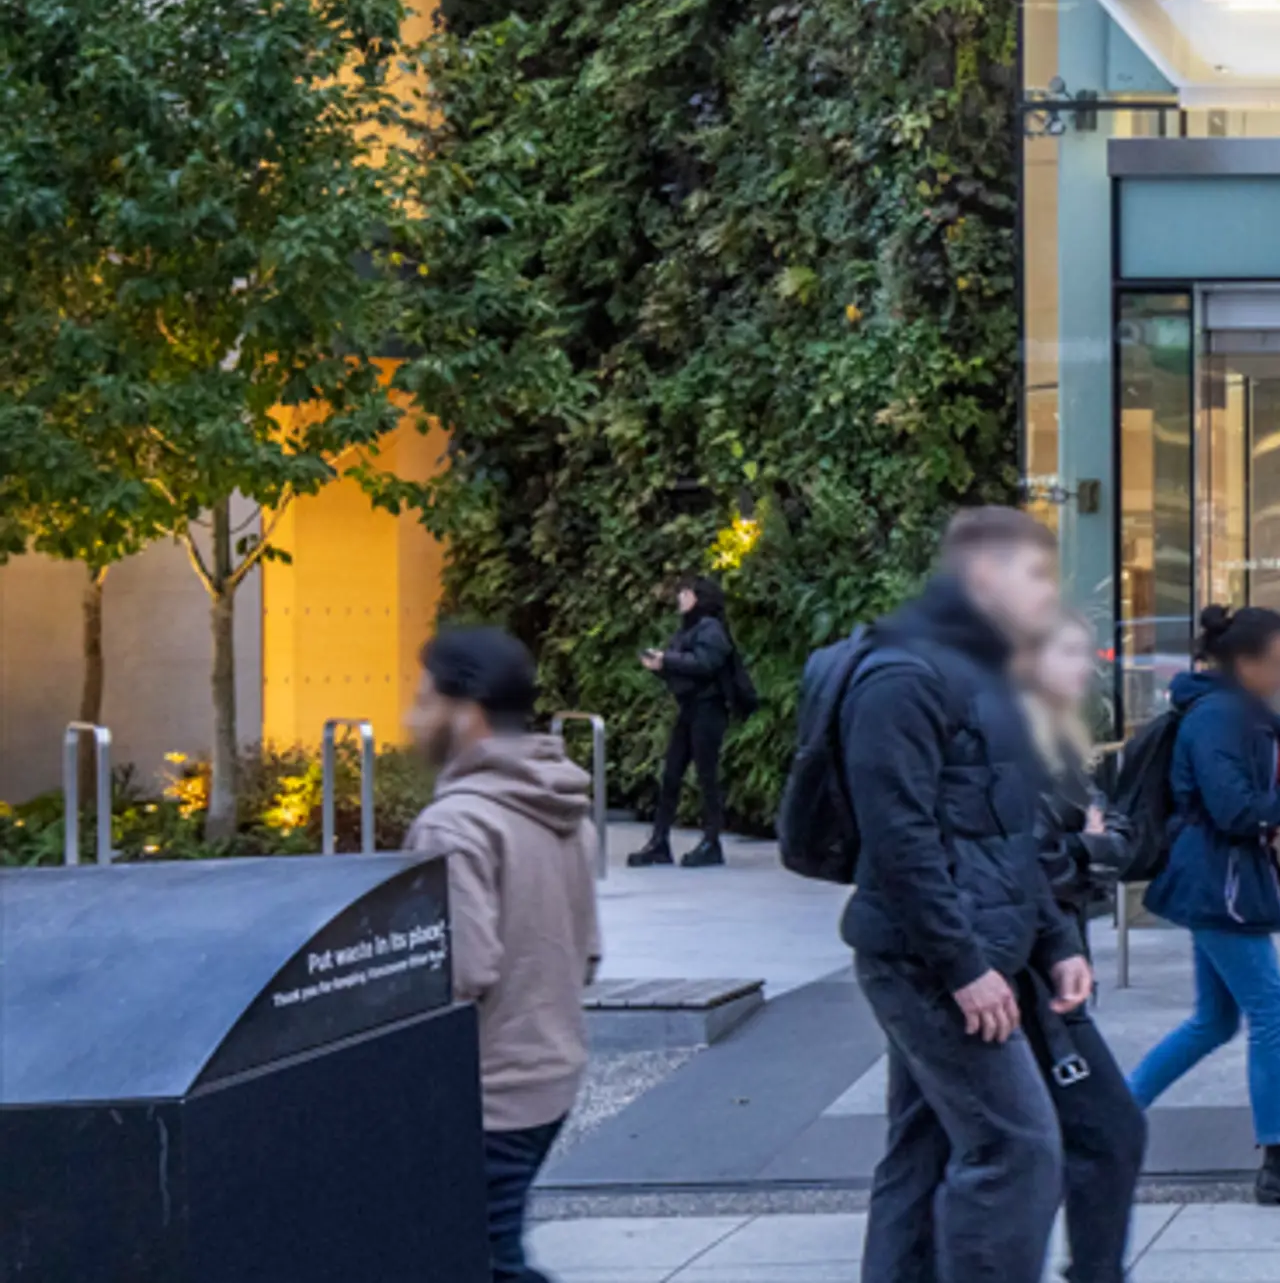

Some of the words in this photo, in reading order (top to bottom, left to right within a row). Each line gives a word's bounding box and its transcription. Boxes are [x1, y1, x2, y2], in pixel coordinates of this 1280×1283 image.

[308, 949, 334, 975] Put
[335, 941, 373, 966] waste
[374, 934, 390, 956] in
[390, 931, 407, 952] its
